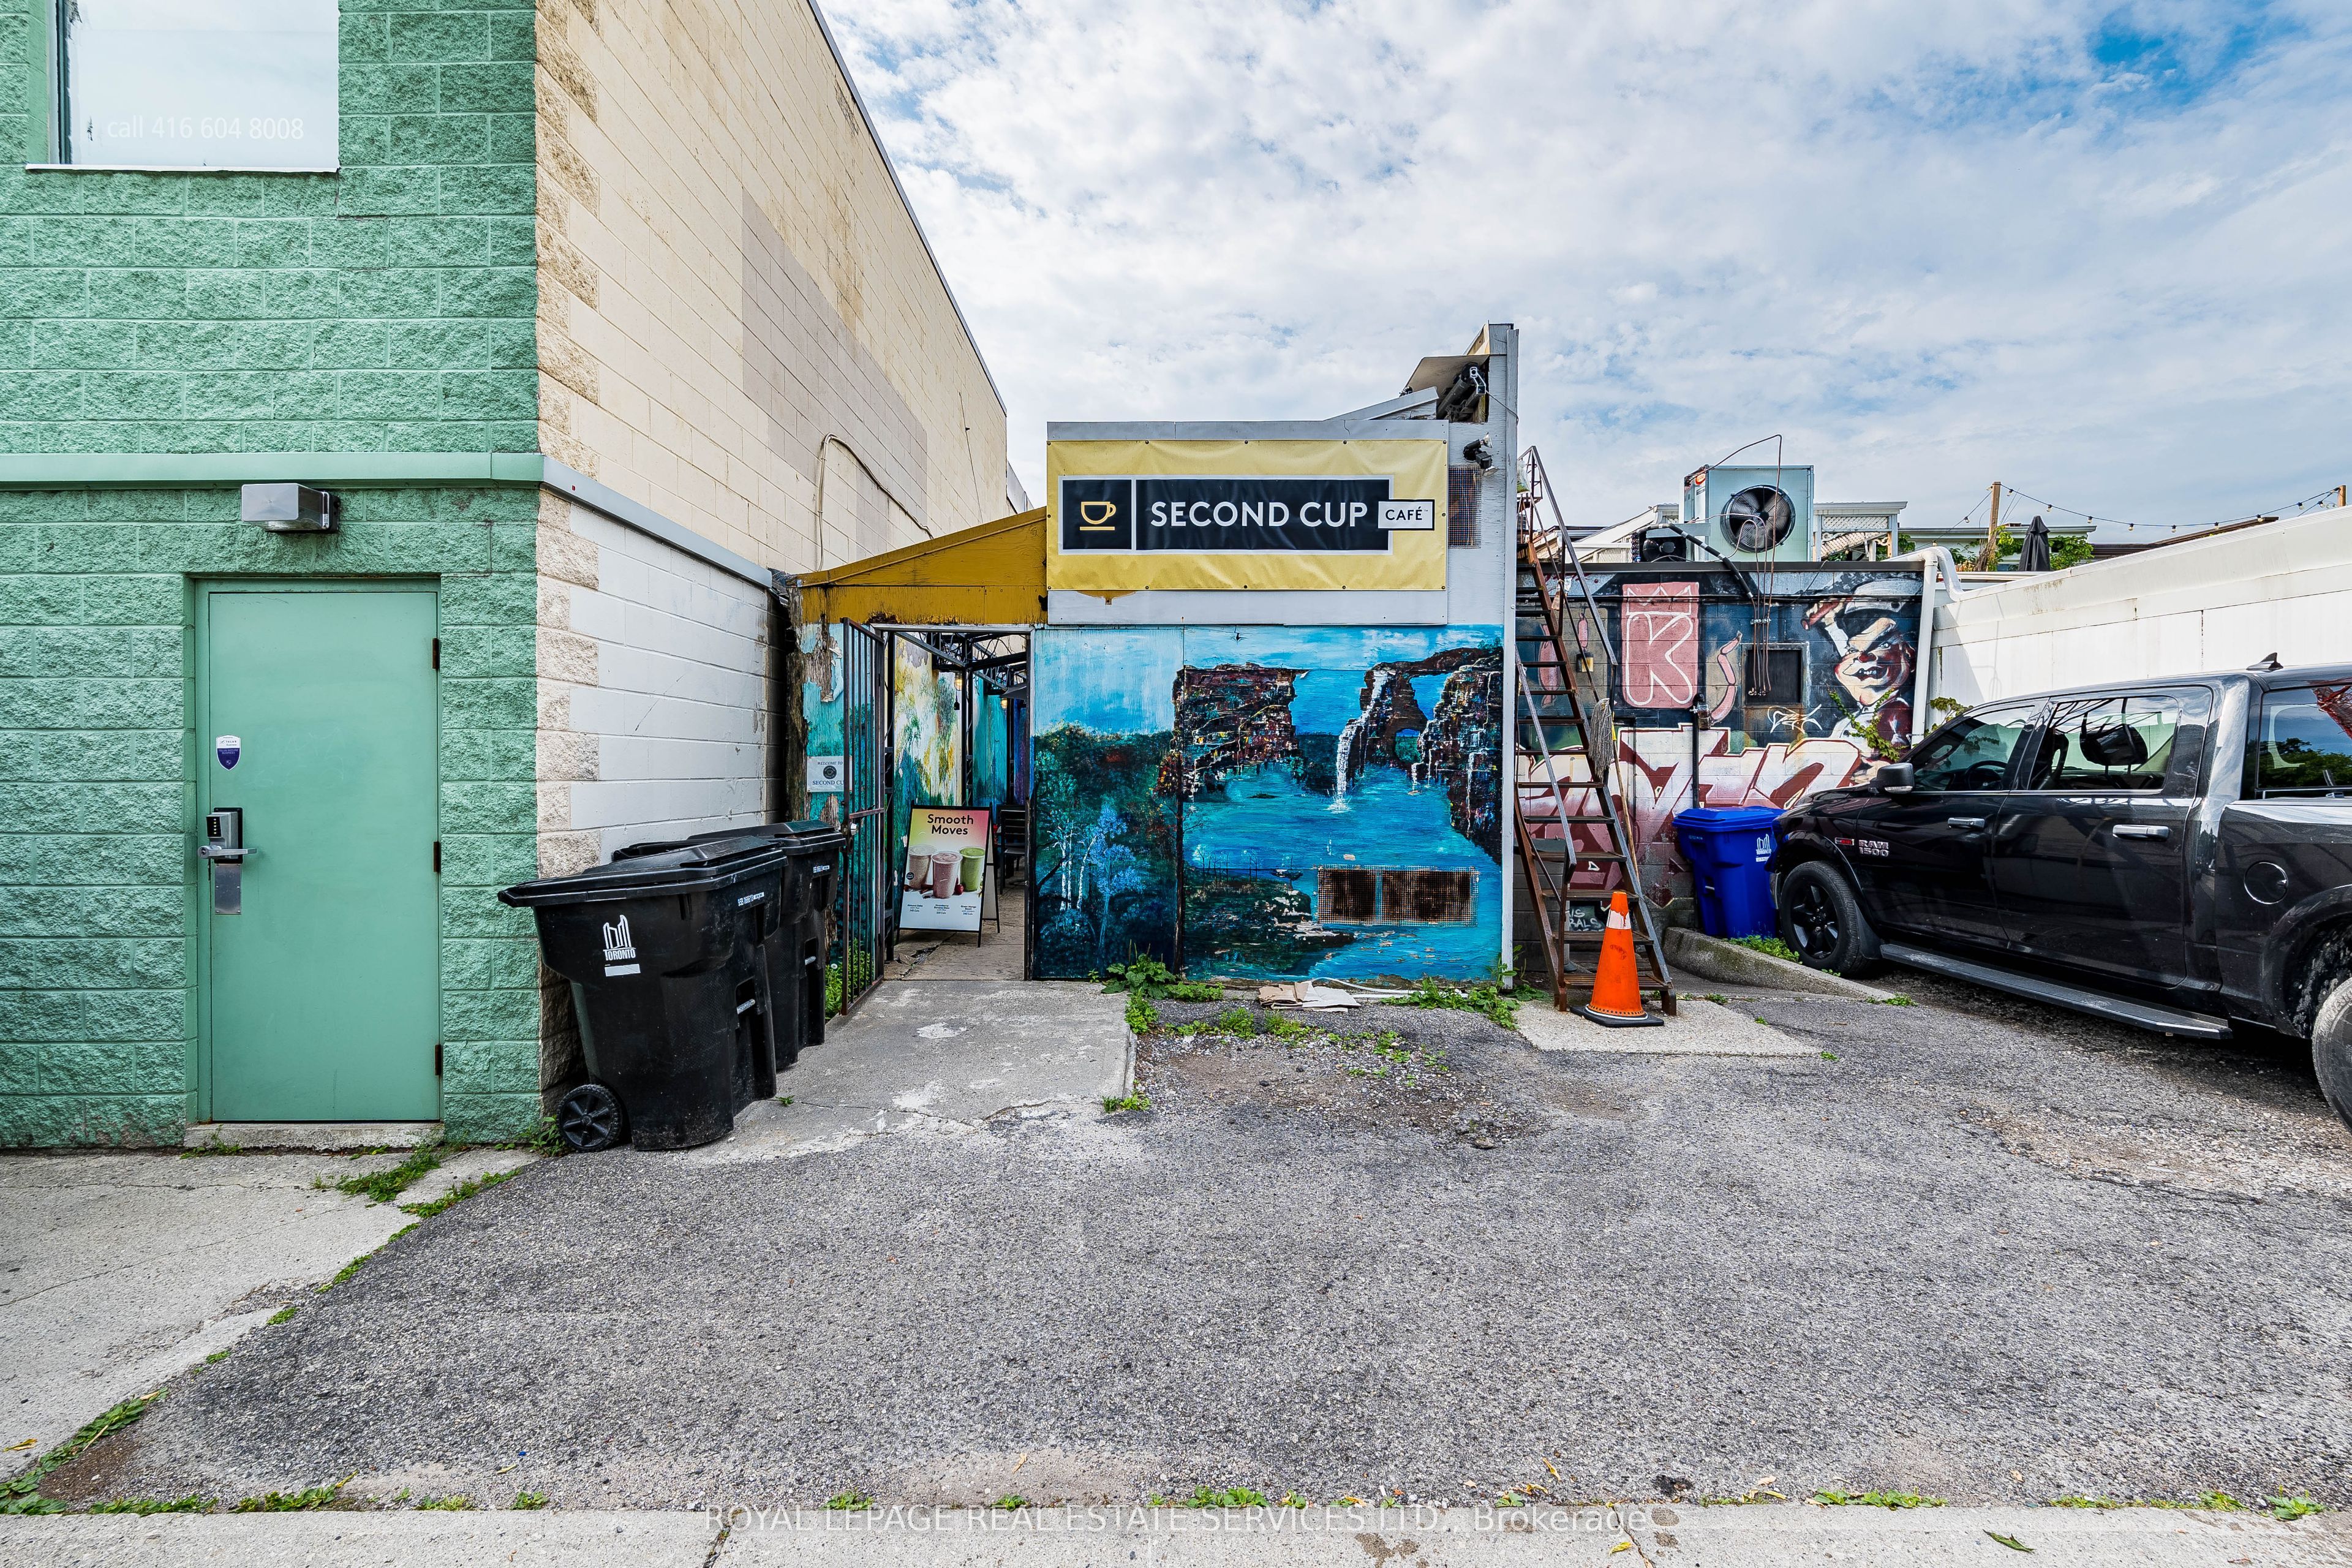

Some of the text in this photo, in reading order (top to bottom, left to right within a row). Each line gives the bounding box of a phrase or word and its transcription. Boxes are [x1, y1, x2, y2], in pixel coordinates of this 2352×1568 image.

[107, 115, 304, 140] call 416 604 8008
[1150, 501, 1368, 527] SECOND CUP
[1385, 506, 1422, 521] CAFÉ
[927, 813, 974, 824] Smooth
[931, 824, 968, 835] Moves
[1858, 839, 1889, 850] RAM
[1858, 846, 1890, 857] 1500
[603, 948, 636, 961] TORONTO
